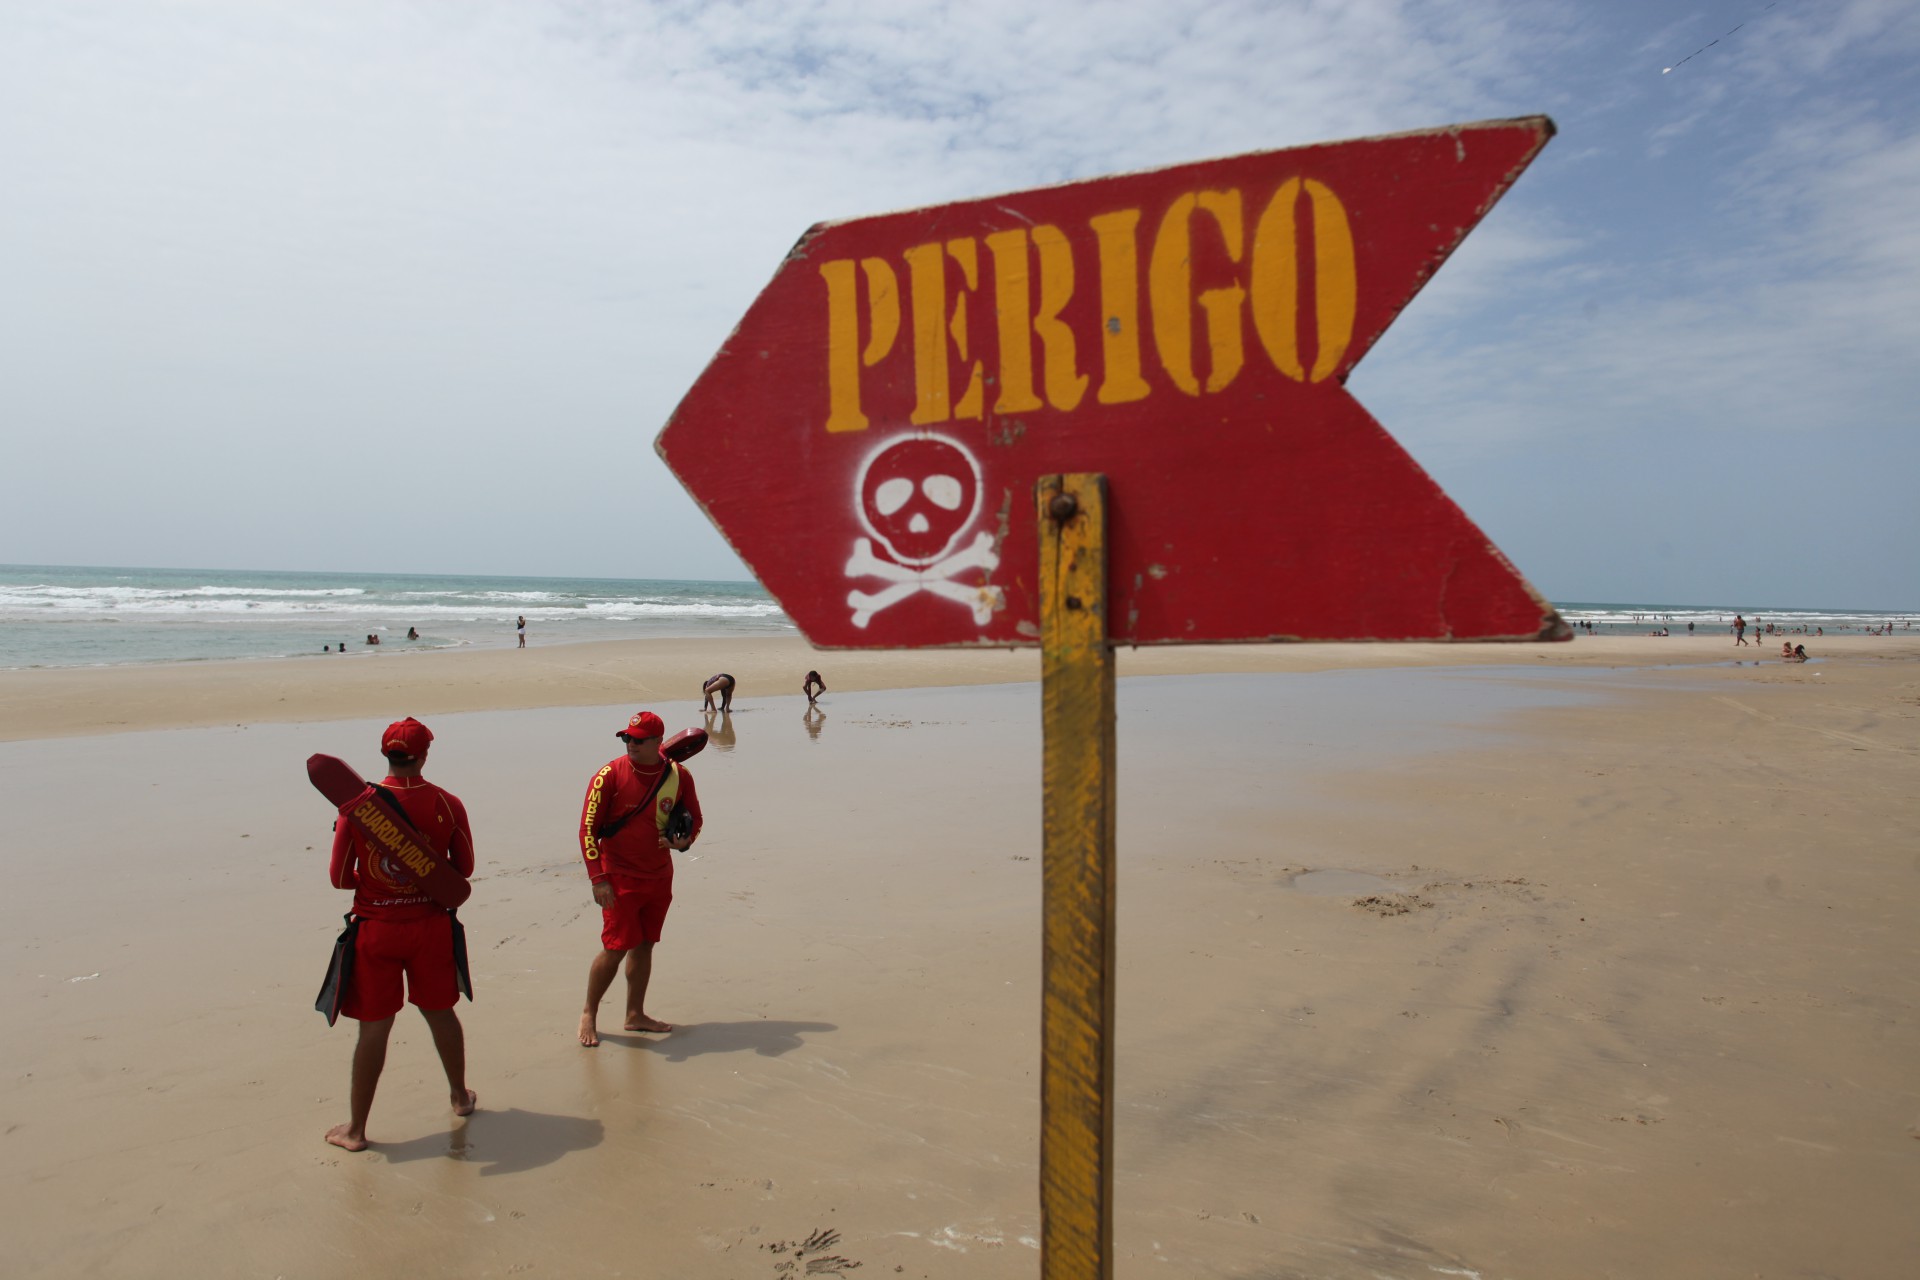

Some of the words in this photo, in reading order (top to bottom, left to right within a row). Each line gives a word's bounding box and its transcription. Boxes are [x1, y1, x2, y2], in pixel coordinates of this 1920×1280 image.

[819, 176, 1357, 434] PERIGO
[354, 800, 435, 877] GUARDA-VIDAS
[584, 765, 612, 860] BOMBEIRO
